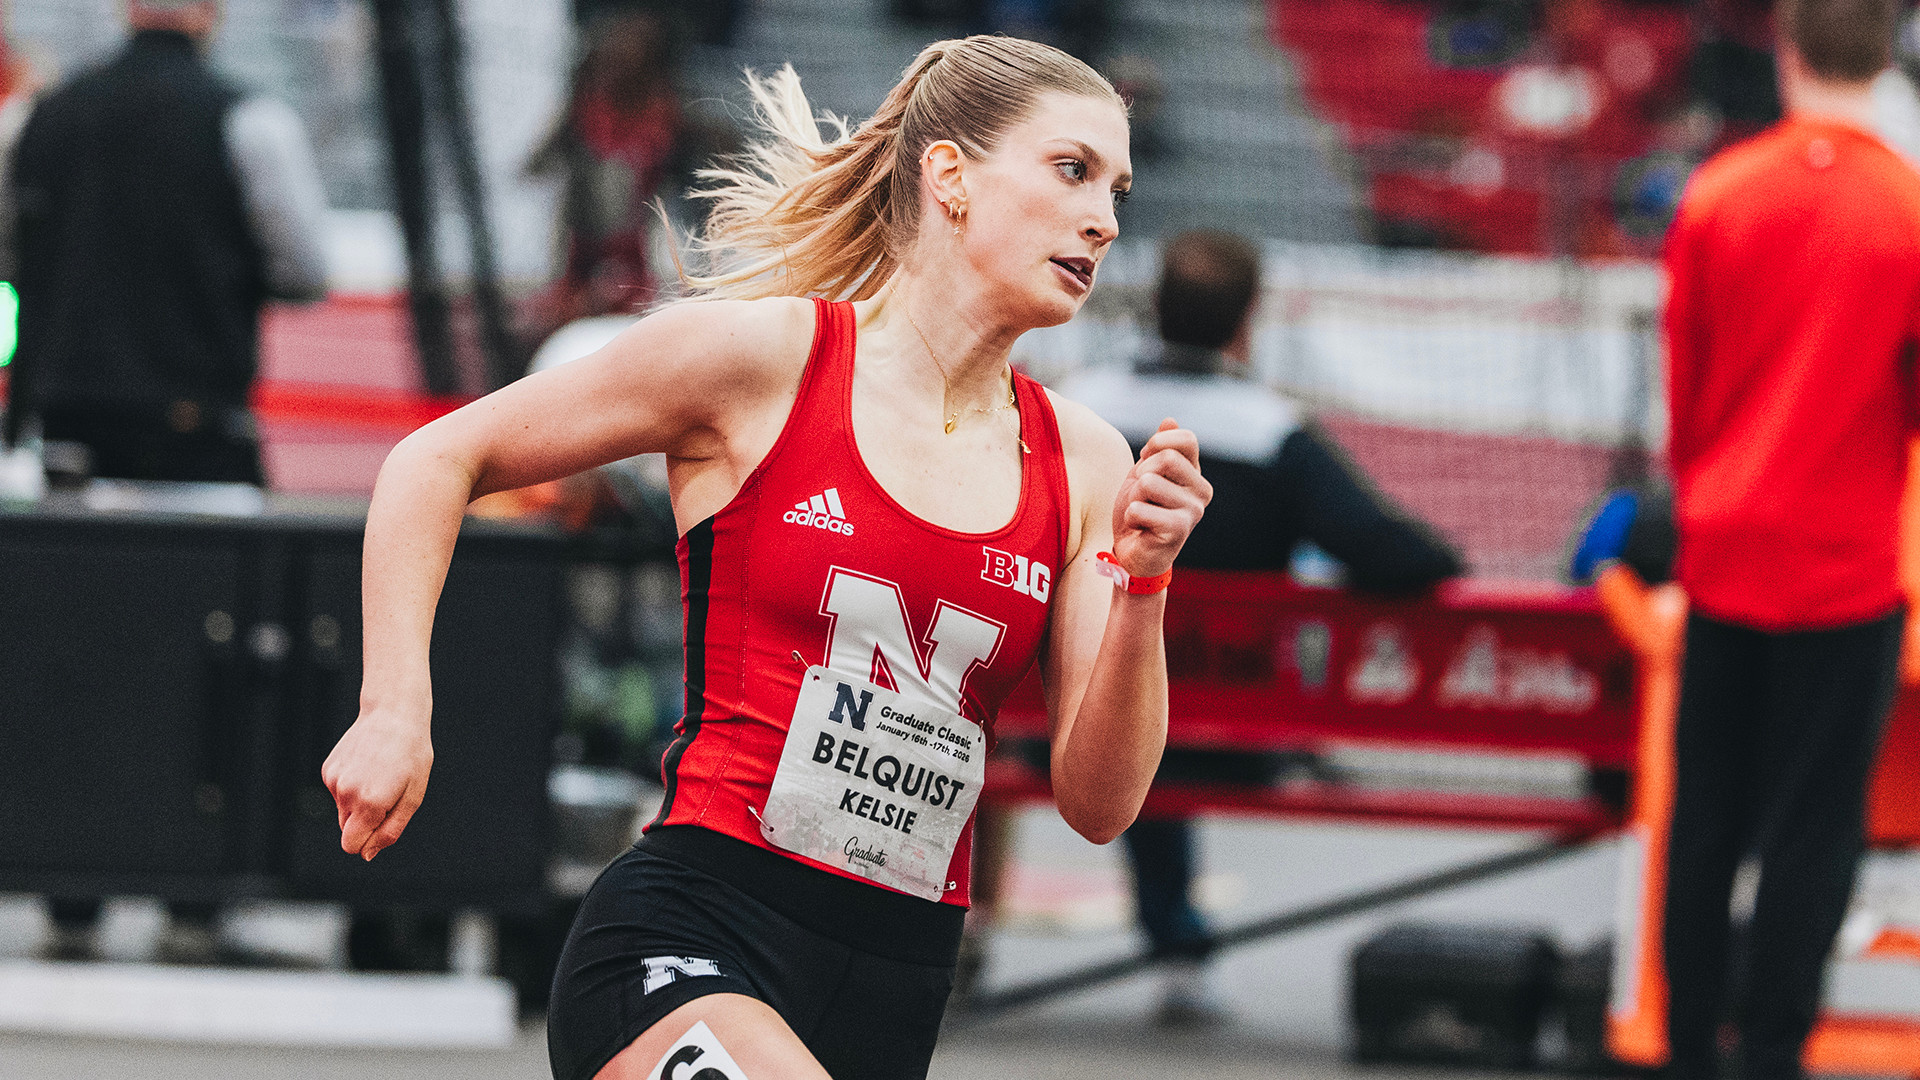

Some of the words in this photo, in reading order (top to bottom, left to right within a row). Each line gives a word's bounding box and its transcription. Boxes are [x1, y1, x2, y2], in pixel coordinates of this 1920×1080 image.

[783, 508, 854, 536] adidas
[819, 565, 1007, 717] N
[828, 682, 874, 732] N
[880, 706, 935, 734] Graduate
[937, 726, 971, 750] Classic
[876, 721, 910, 740] January
[911, 734, 928, 746] 16th
[952, 749, 970, 763] 2026
[812, 731, 965, 810] BELQUIST
[838, 788, 917, 834] KELSIE
[844, 836, 888, 867] Graduate
[641, 955, 728, 995] N
